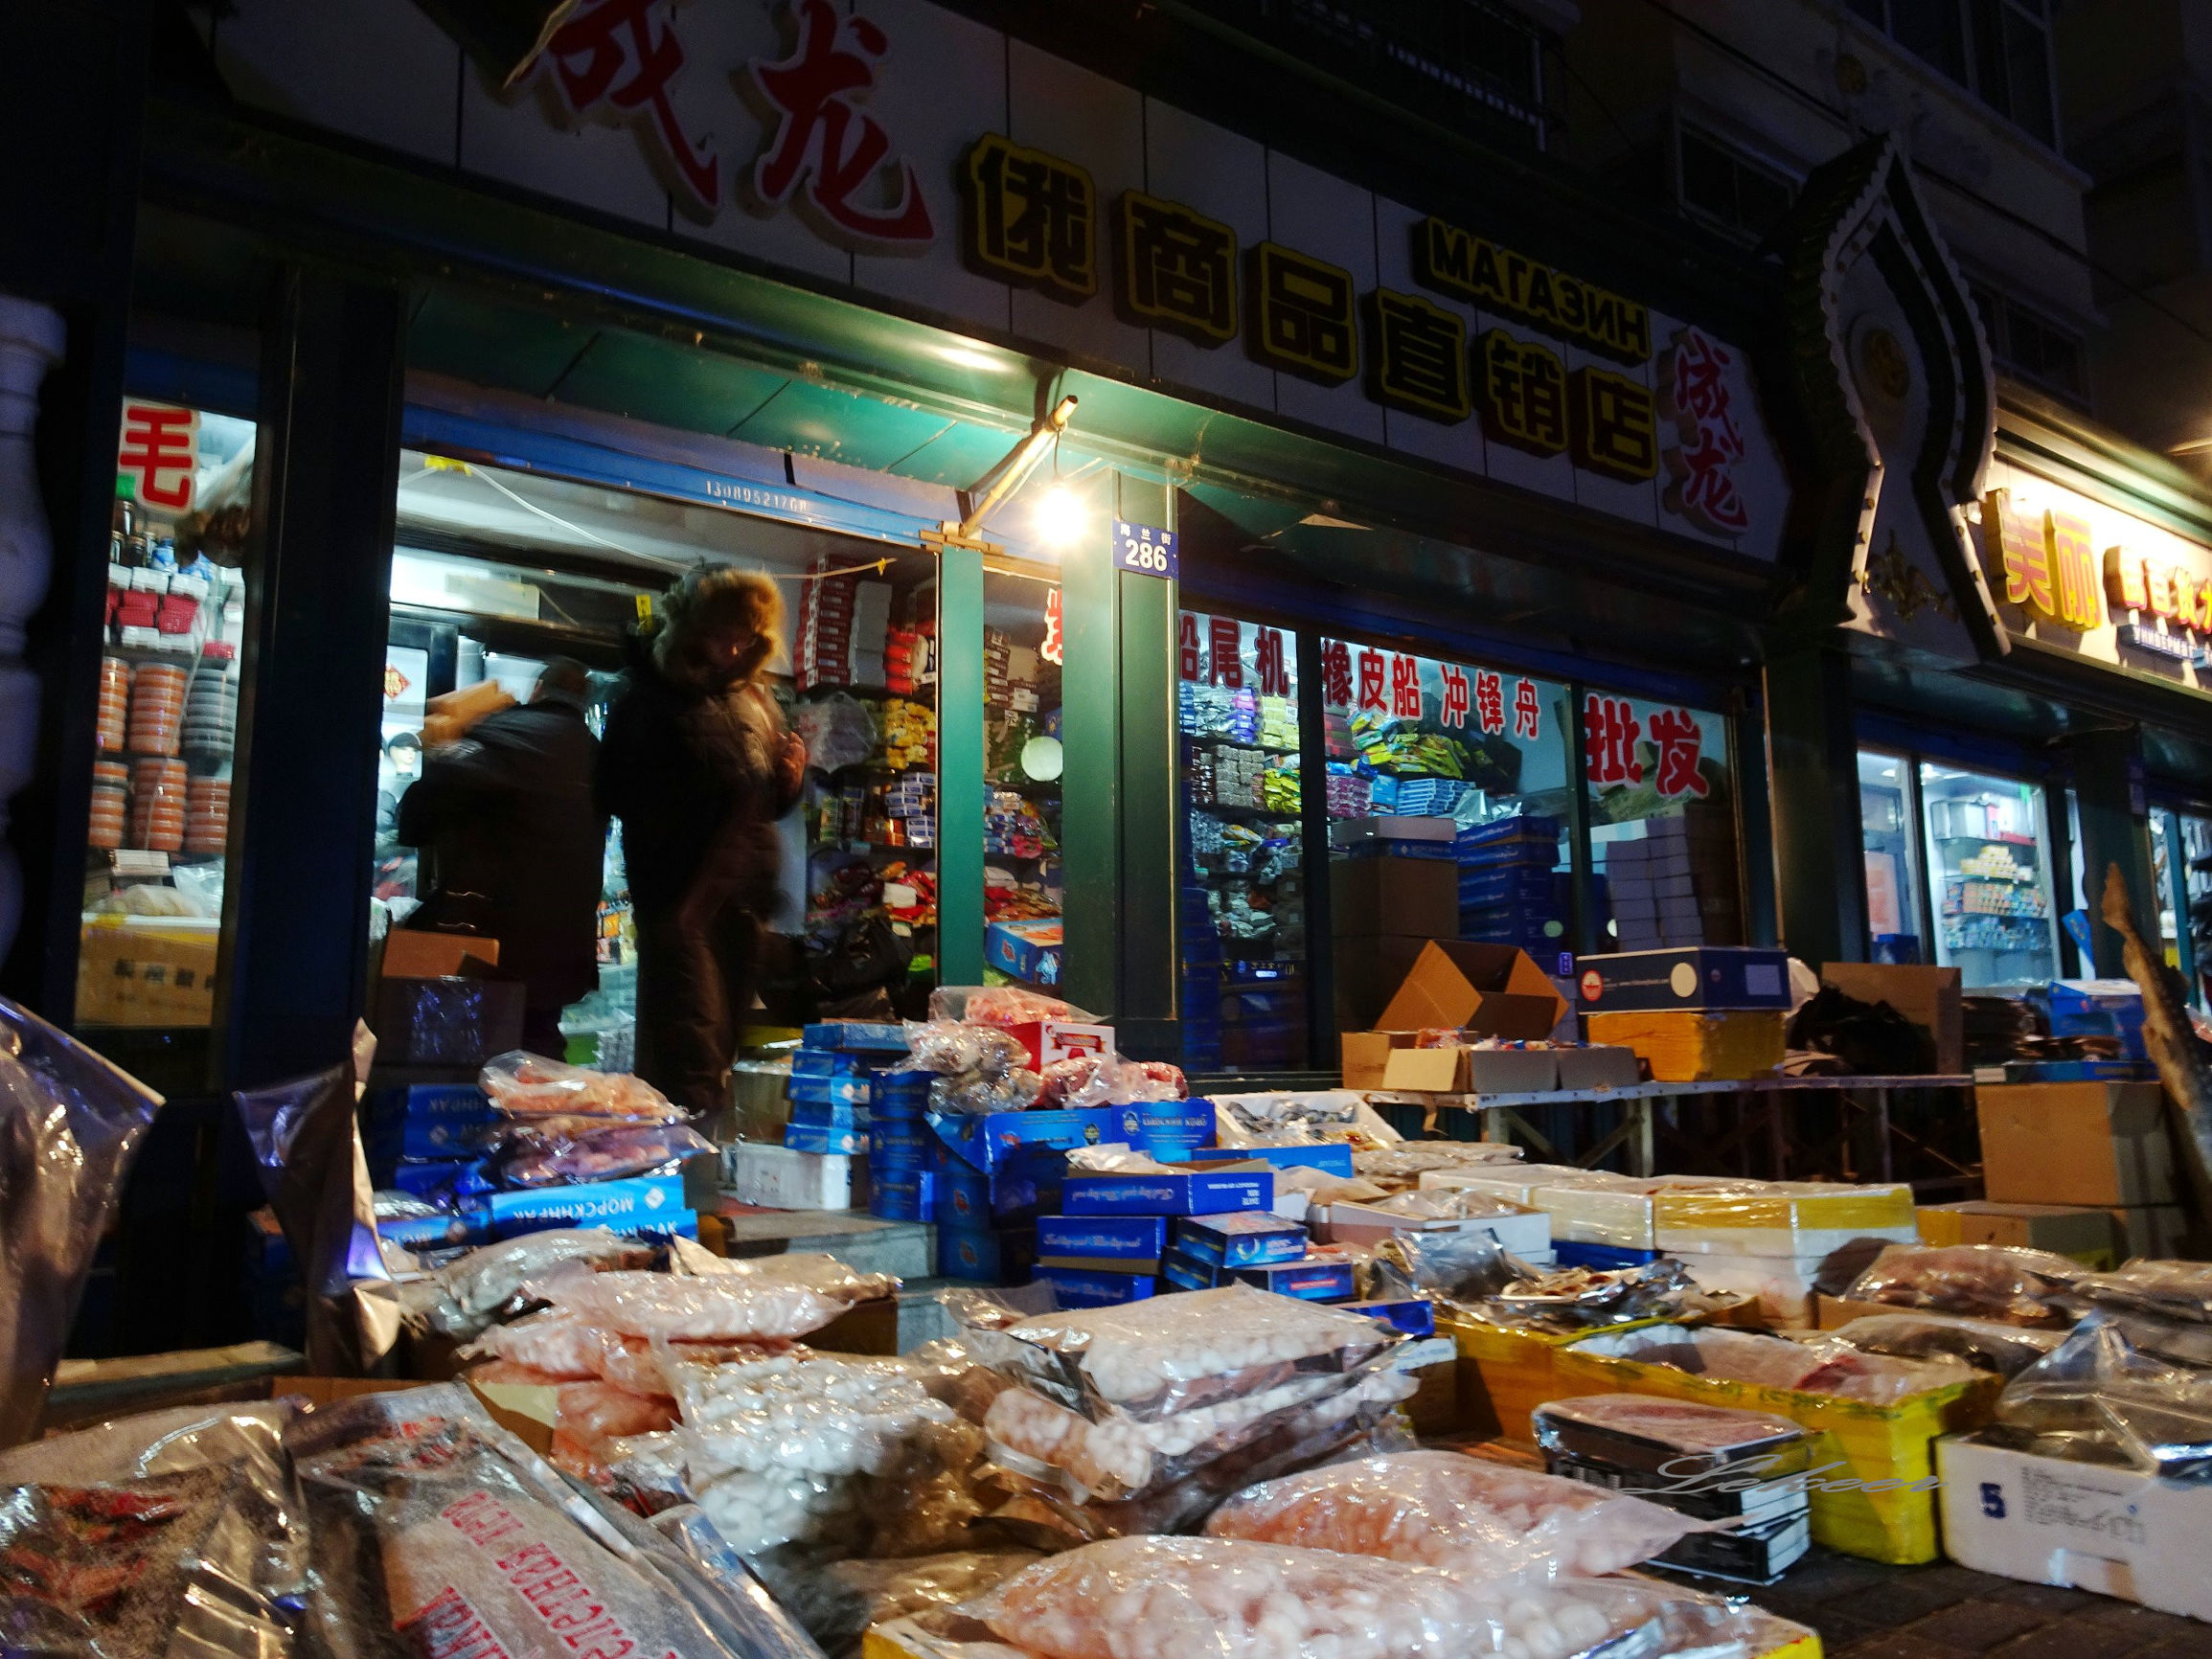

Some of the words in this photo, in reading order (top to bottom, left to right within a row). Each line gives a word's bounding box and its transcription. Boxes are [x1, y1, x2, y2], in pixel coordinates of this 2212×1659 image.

[973, 137, 1658, 480] 俄商品直销店
[1430, 218, 1651, 357] МАГАЗИН
[119, 408, 194, 508] 毛
[1125, 538, 1168, 572] 286
[1322, 638, 1423, 720] 橡皮船
[1441, 663, 1540, 739] 冲锋舟
[1585, 693, 1709, 798] 批发
[1979, 1482, 2007, 1519] 5
